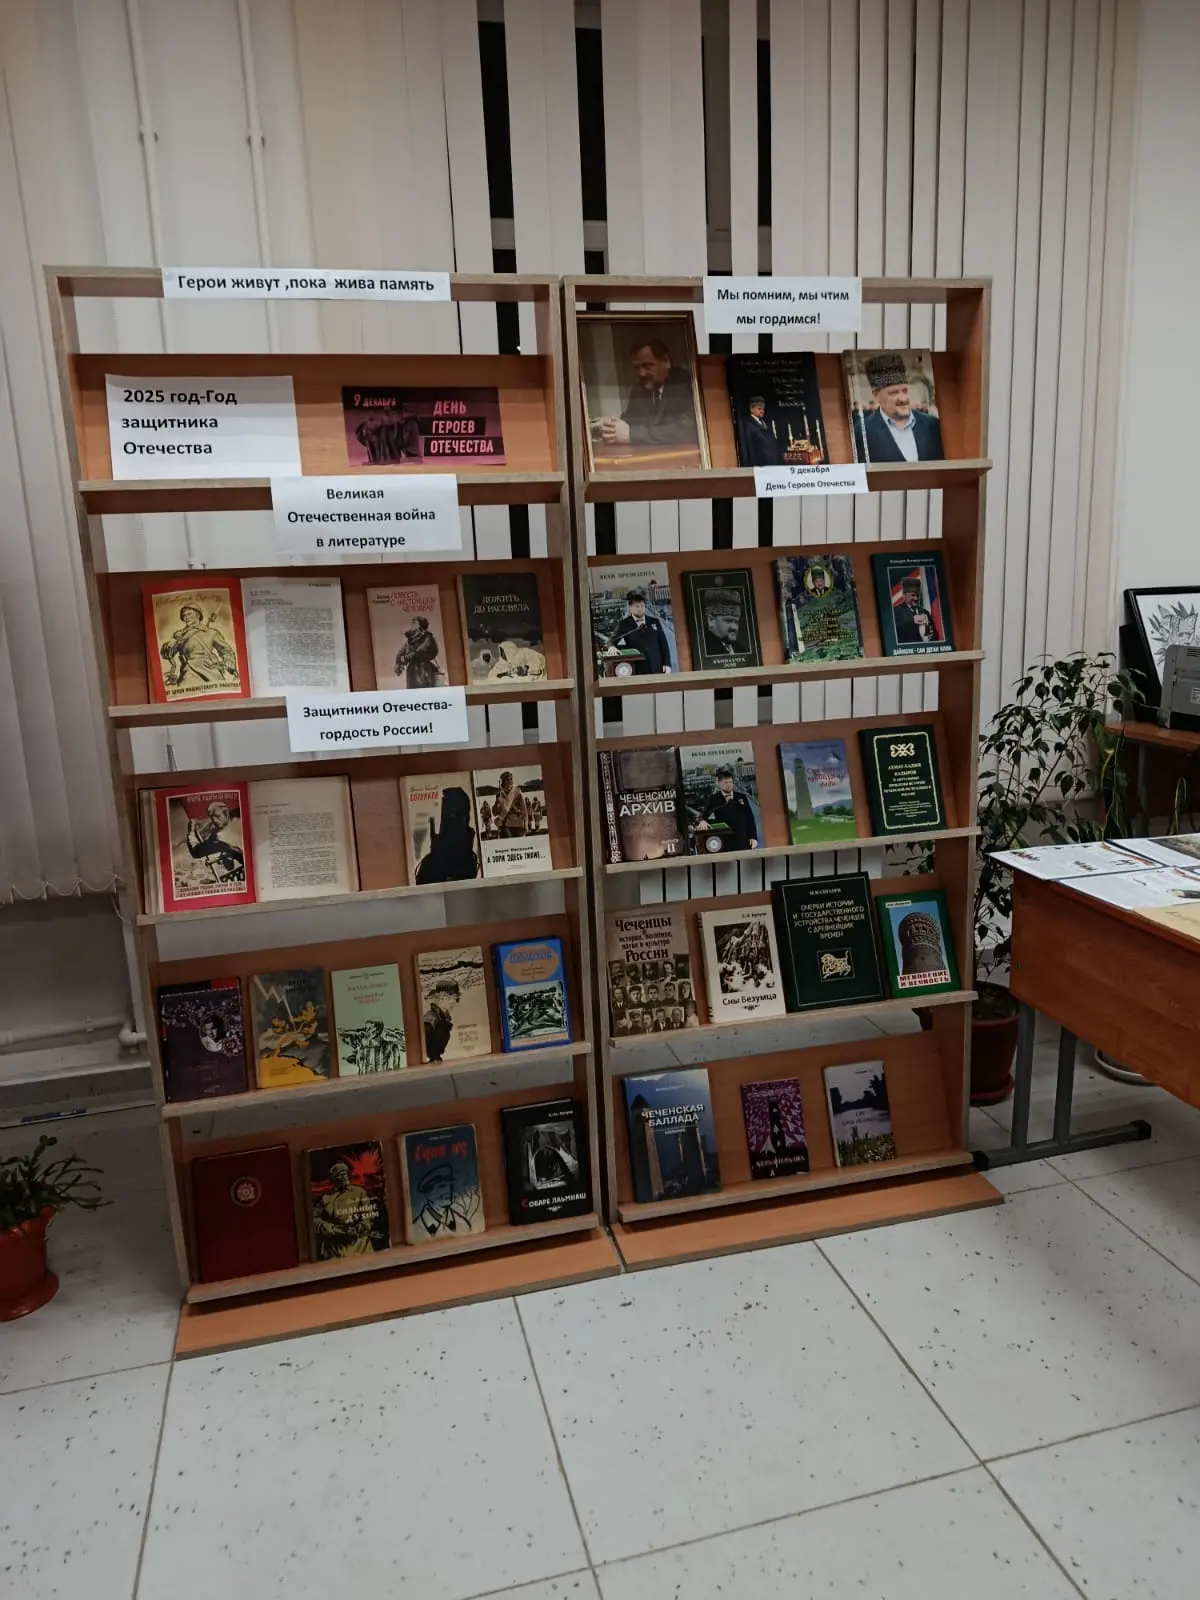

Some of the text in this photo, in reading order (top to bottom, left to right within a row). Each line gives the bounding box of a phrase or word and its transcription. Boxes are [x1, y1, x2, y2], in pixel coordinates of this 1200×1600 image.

[178, 275, 227, 291] Герои
[231, 277, 280, 291] живут
[334, 278, 375, 290] жива
[379, 280, 434, 292] память
[717, 289, 849, 302] Мы помним, мы чтим
[736, 312, 821, 327] мы гордимся!
[123, 389, 238, 405] 2025 год-Год
[353, 394, 361, 407] 9
[432, 400, 467, 416] ДЕНЬ
[121, 417, 219, 432] защитника
[431, 420, 475, 434] ГЕРОЕВ
[123, 441, 213, 455] Отечества
[429, 439, 494, 454] ОТЕЧЕСТВА
[789, 466, 830, 475] 9 декабря
[765, 480, 856, 491] День Героев Отечества
[326, 488, 385, 500] Великая
[287, 508, 436, 523] Отечественная война
[316, 536, 406, 549] в литературе
[481, 594, 520, 604] ДОЖИТЬ
[472, 603, 530, 614] ДО РАССВЕТА
[303, 700, 453, 719] Защитники Отечества-
[320, 722, 434, 742] гордость России!
[619, 788, 677, 804] ЧЕЧЕНСКИЙ
[619, 800, 676, 817] АРХИВ
[487, 856, 491, 864] А
[507, 852, 523, 862] ЗДЕСЬ
[800, 900, 854, 911] ОЧЕРКИ ИСТОРИИ
[801, 905, 865, 919] ГОСУДАРСТВЕННОГО
[615, 917, 672, 932] Чеченцы
[794, 913, 865, 928] УСТРОЙСТВА ЧЕЧЕНЦЕВ
[813, 922, 854, 933] ДРЕВНЕЙШИХ
[625, 949, 669, 963] России
[899, 970, 948, 981] МГНОВЕНИЕ
[908, 977, 949, 987] ВЕЧНОСТЬ
[722, 992, 777, 1006] Сны Безумца
[641, 1103, 704, 1118] ЧЕЧЕНСКАЯ
[648, 1113, 700, 1127] БАЛЛАДА
[345, 1211, 380, 1224] ДУХОМ
